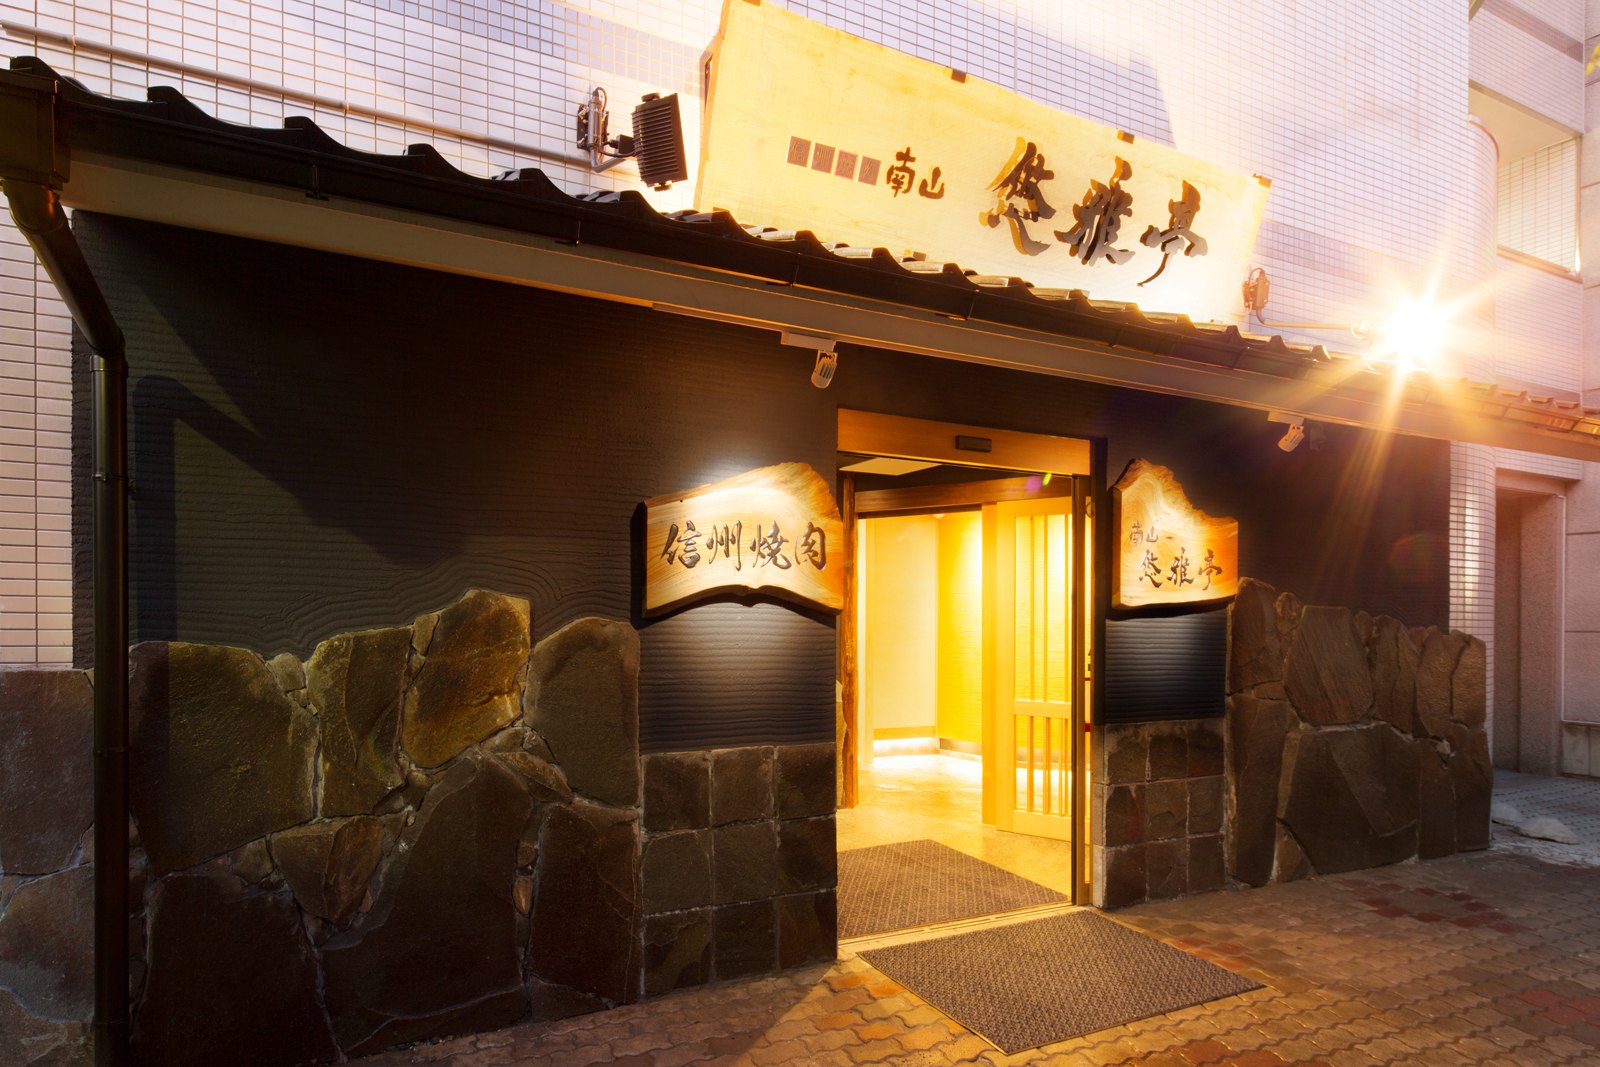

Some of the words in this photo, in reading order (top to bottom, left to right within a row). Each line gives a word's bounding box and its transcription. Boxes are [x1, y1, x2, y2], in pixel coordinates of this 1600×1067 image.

[886, 147, 945, 199] 南山
[661, 520, 827, 571] 信州焼肉
[1129, 521, 1158, 544] 南山
[1139, 547, 1223, 590] 悠雅亭
